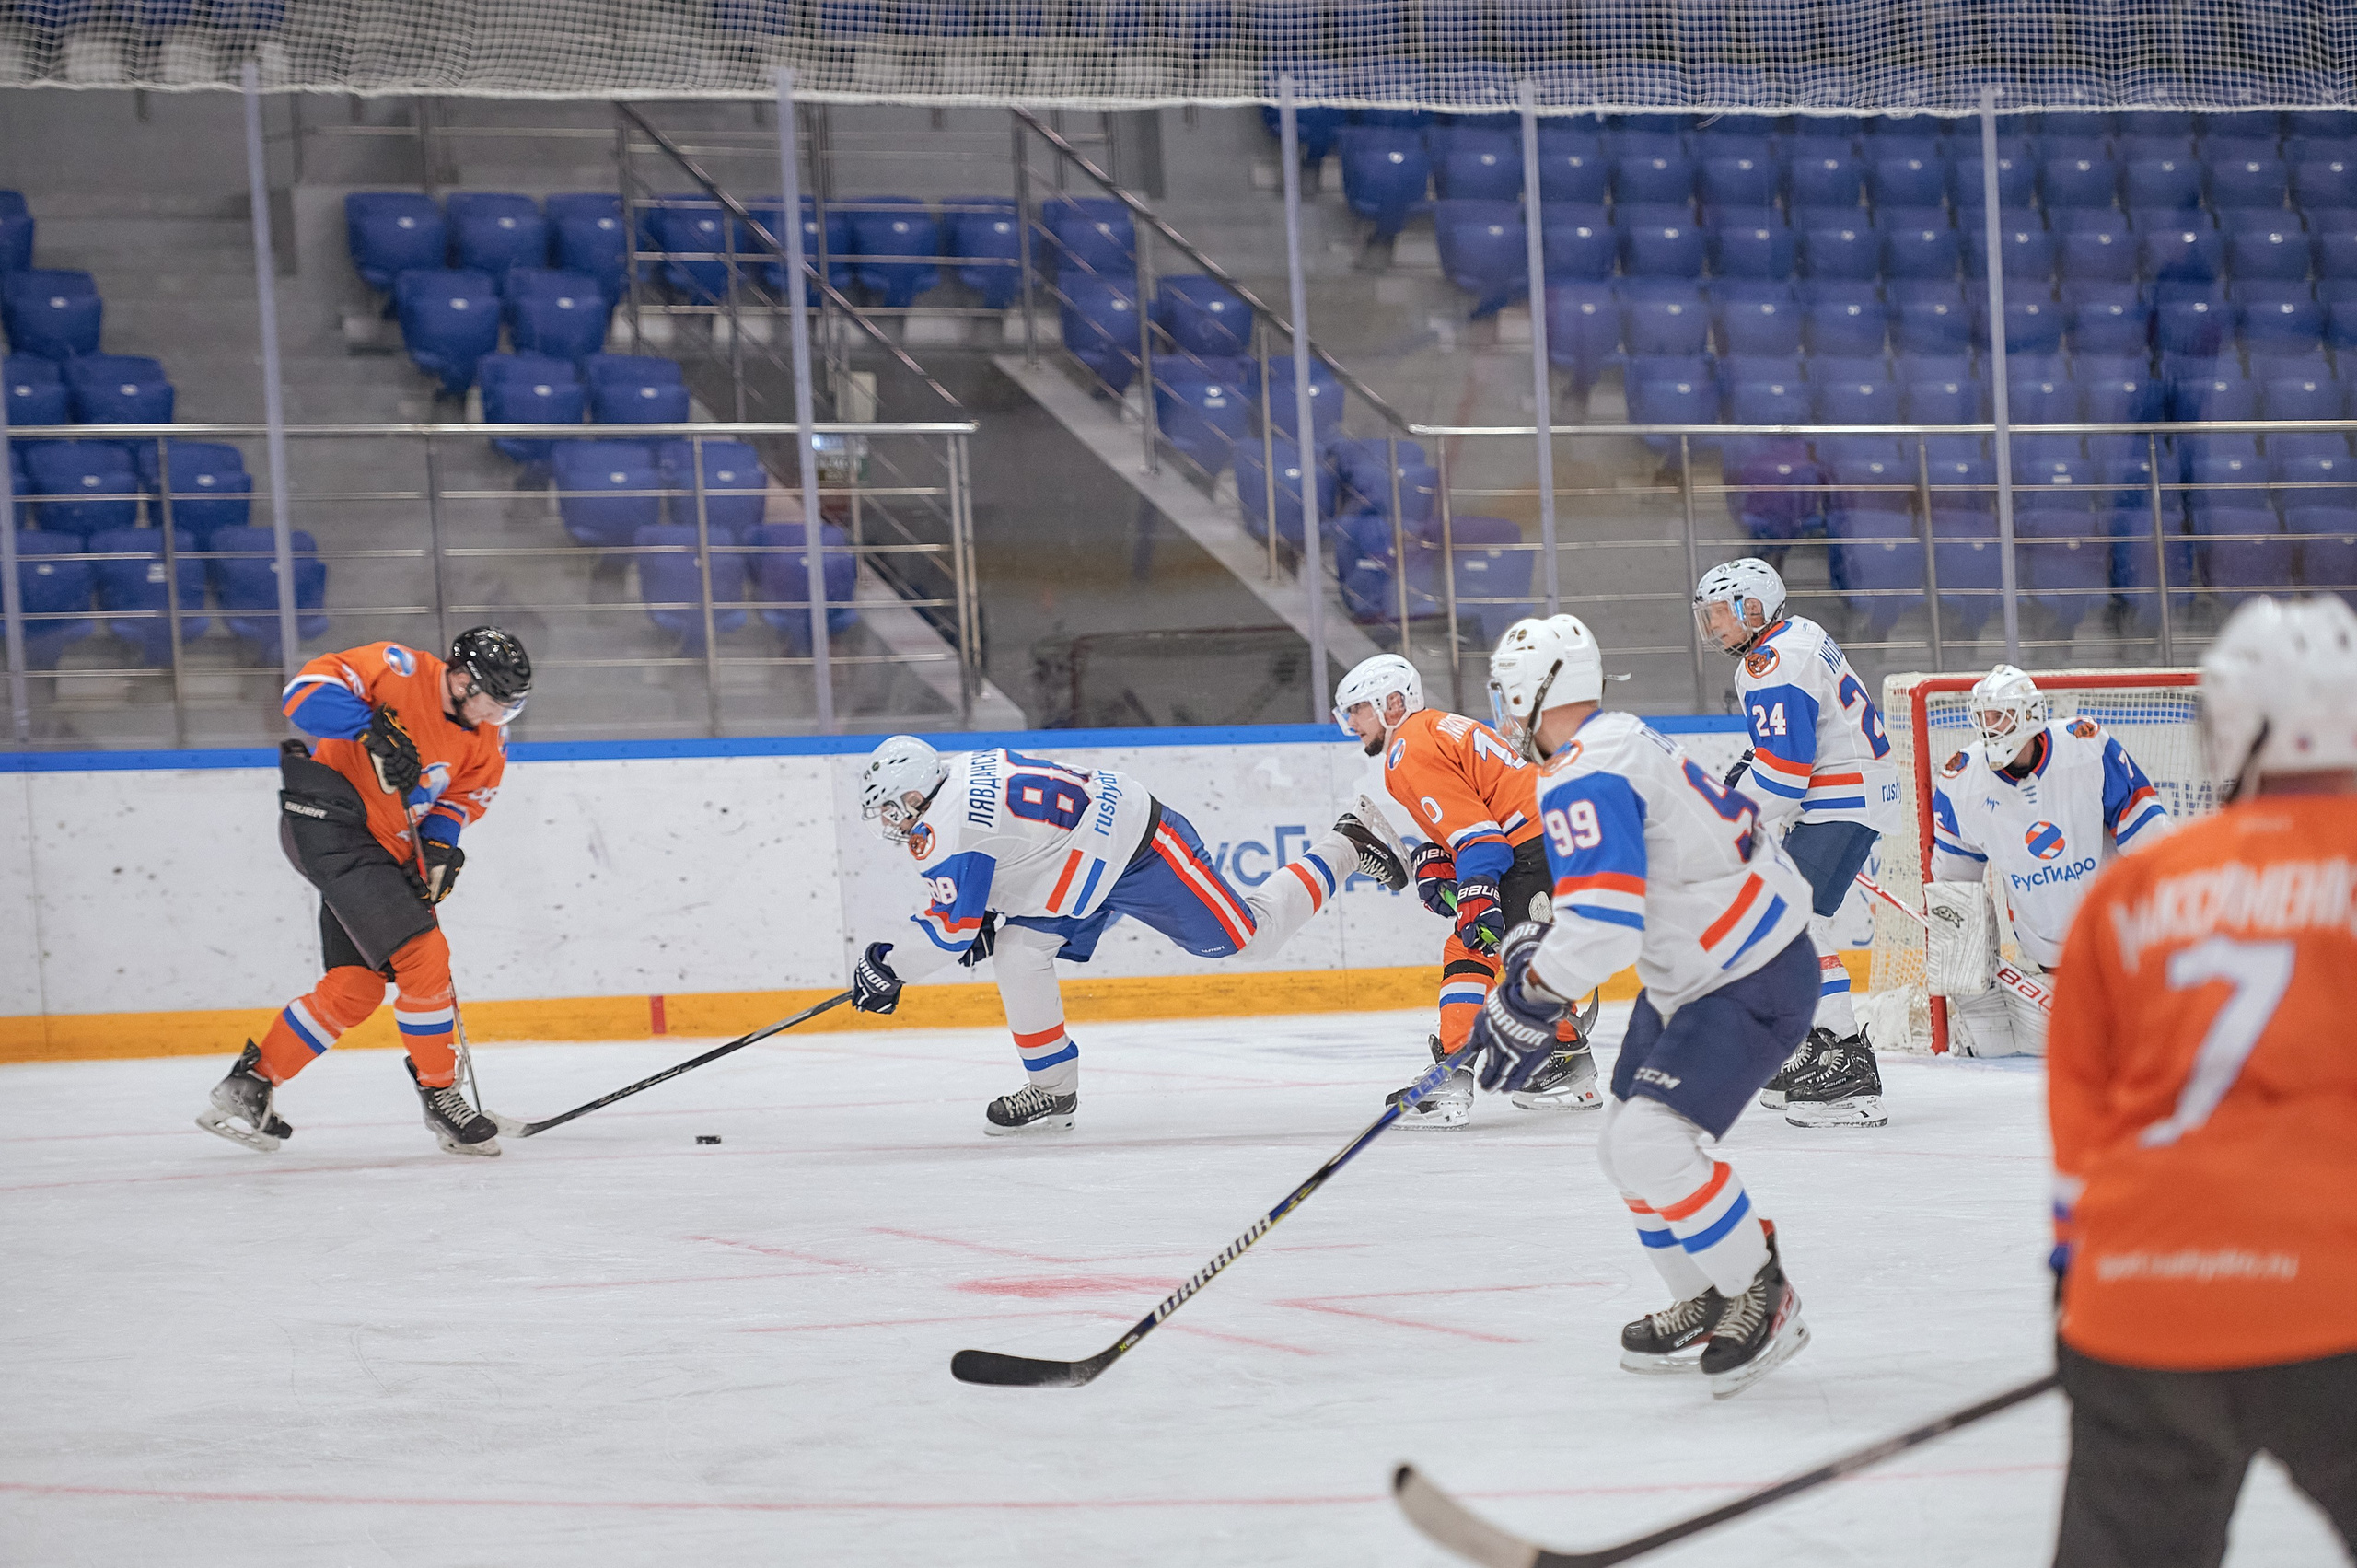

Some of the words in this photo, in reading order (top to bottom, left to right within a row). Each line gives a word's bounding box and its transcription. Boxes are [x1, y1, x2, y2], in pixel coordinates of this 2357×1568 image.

[1752, 703, 1787, 737] 24
[1544, 799, 1603, 858] 99
[2010, 857, 2096, 892] РусГидро
[2138, 935, 2297, 1147] 7
[1634, 1067, 1682, 1090] CCM
[1153, 1213, 1274, 1324] WARRIOR
[1674, 1326, 1704, 1349] CCM
